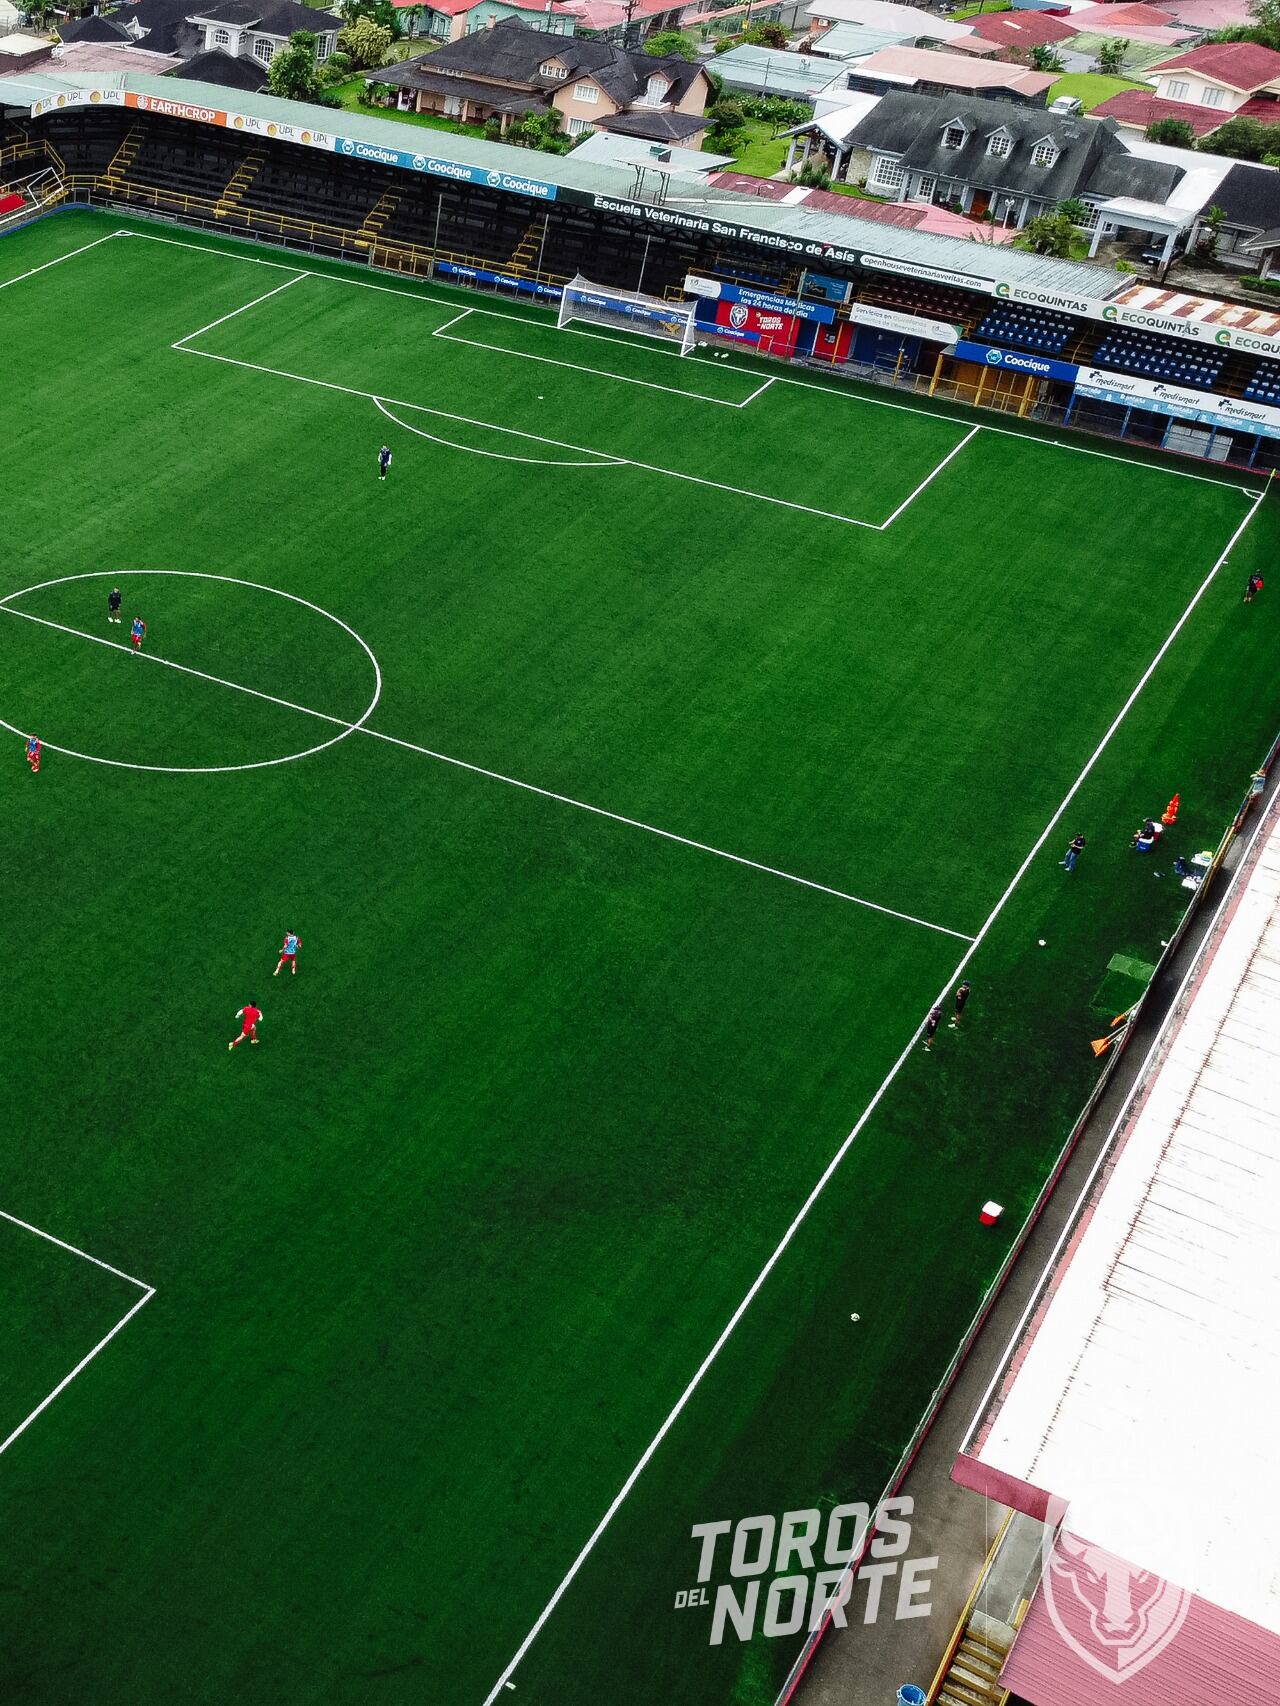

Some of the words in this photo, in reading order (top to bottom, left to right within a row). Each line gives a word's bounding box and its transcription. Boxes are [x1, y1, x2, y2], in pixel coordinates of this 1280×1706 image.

[67, 91, 83, 102] UPL
[103, 90, 121, 100] UPL
[150, 98, 216, 122] EARTHCROP
[245, 117, 261, 130] UPL
[278, 126, 295, 137] UPL
[313, 133, 329, 145] UPL
[356, 144, 398, 164] Coocique
[428, 160, 471, 180] Coocique
[503, 176, 548, 197] Coocique
[593, 196, 641, 216] Escuela
[644, 207, 709, 231] Veterinaria
[711, 222, 736, 237] San
[739, 228, 803, 251] Francisco
[806, 243, 823, 256] de
[825, 247, 855, 263] Asís
[864, 257, 982, 288] openhouseveterinariaveritas.com
[1013, 288, 1088, 313] ECOQUINTAS
[1121, 311, 1199, 337] ECOQUINTAS
[1004, 354, 1051, 372] Coocique
[1095, 376, 1136, 392] medismart
[1158, 390, 1201, 406] medismart
[1224, 405, 1267, 421] medismart
